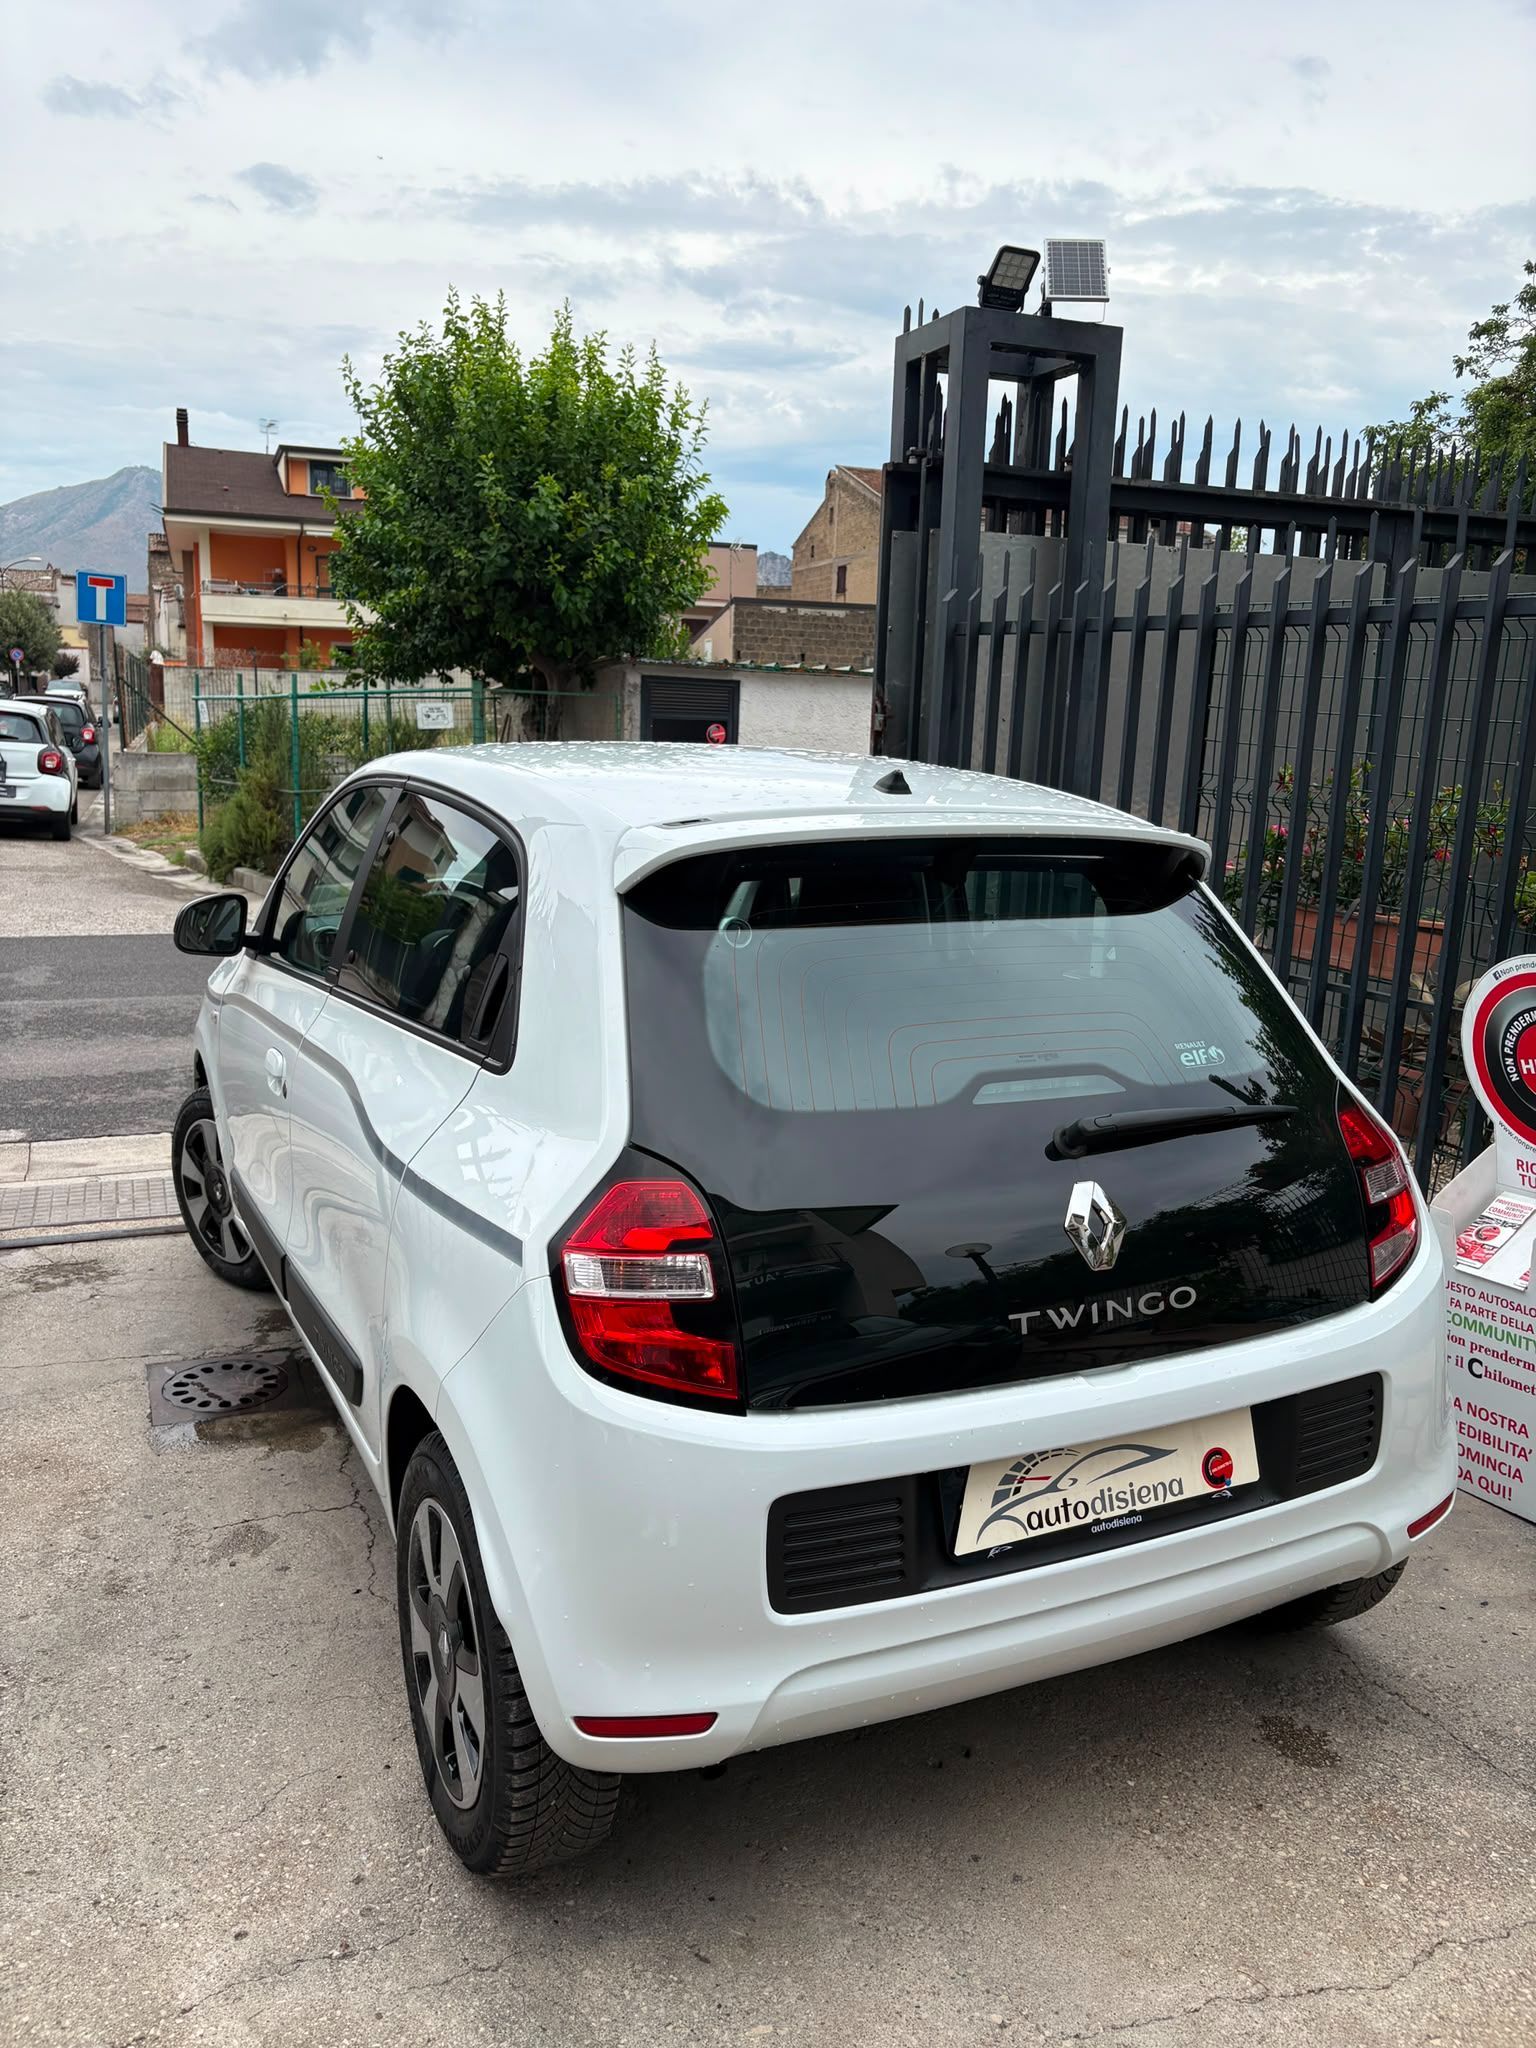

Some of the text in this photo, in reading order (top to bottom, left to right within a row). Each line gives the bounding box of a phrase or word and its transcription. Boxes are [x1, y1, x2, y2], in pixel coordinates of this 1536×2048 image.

[1174, 1040, 1206, 1050] RENAULT
[1180, 1049, 1207, 1066] elf
[1504, 1058, 1519, 1081] NON
[1519, 1173, 1536, 1189] TU
[1008, 1286, 1197, 1335] TWINGO
[1449, 1297, 1535, 1335] FA PARTE DELLA
[1478, 1291, 1536, 1318] AUTOSALO
[1455, 1355, 1464, 1368] il
[1469, 1341, 1536, 1373] prenderm
[1466, 1402, 1529, 1438] NOSTRA
[1456, 1420, 1533, 1462] EDIBILITA'
[1477, 1475, 1512, 1501] QUI!
[1026, 1477, 1184, 1531] autodisiena
[1091, 1514, 1142, 1534] autodisiena
